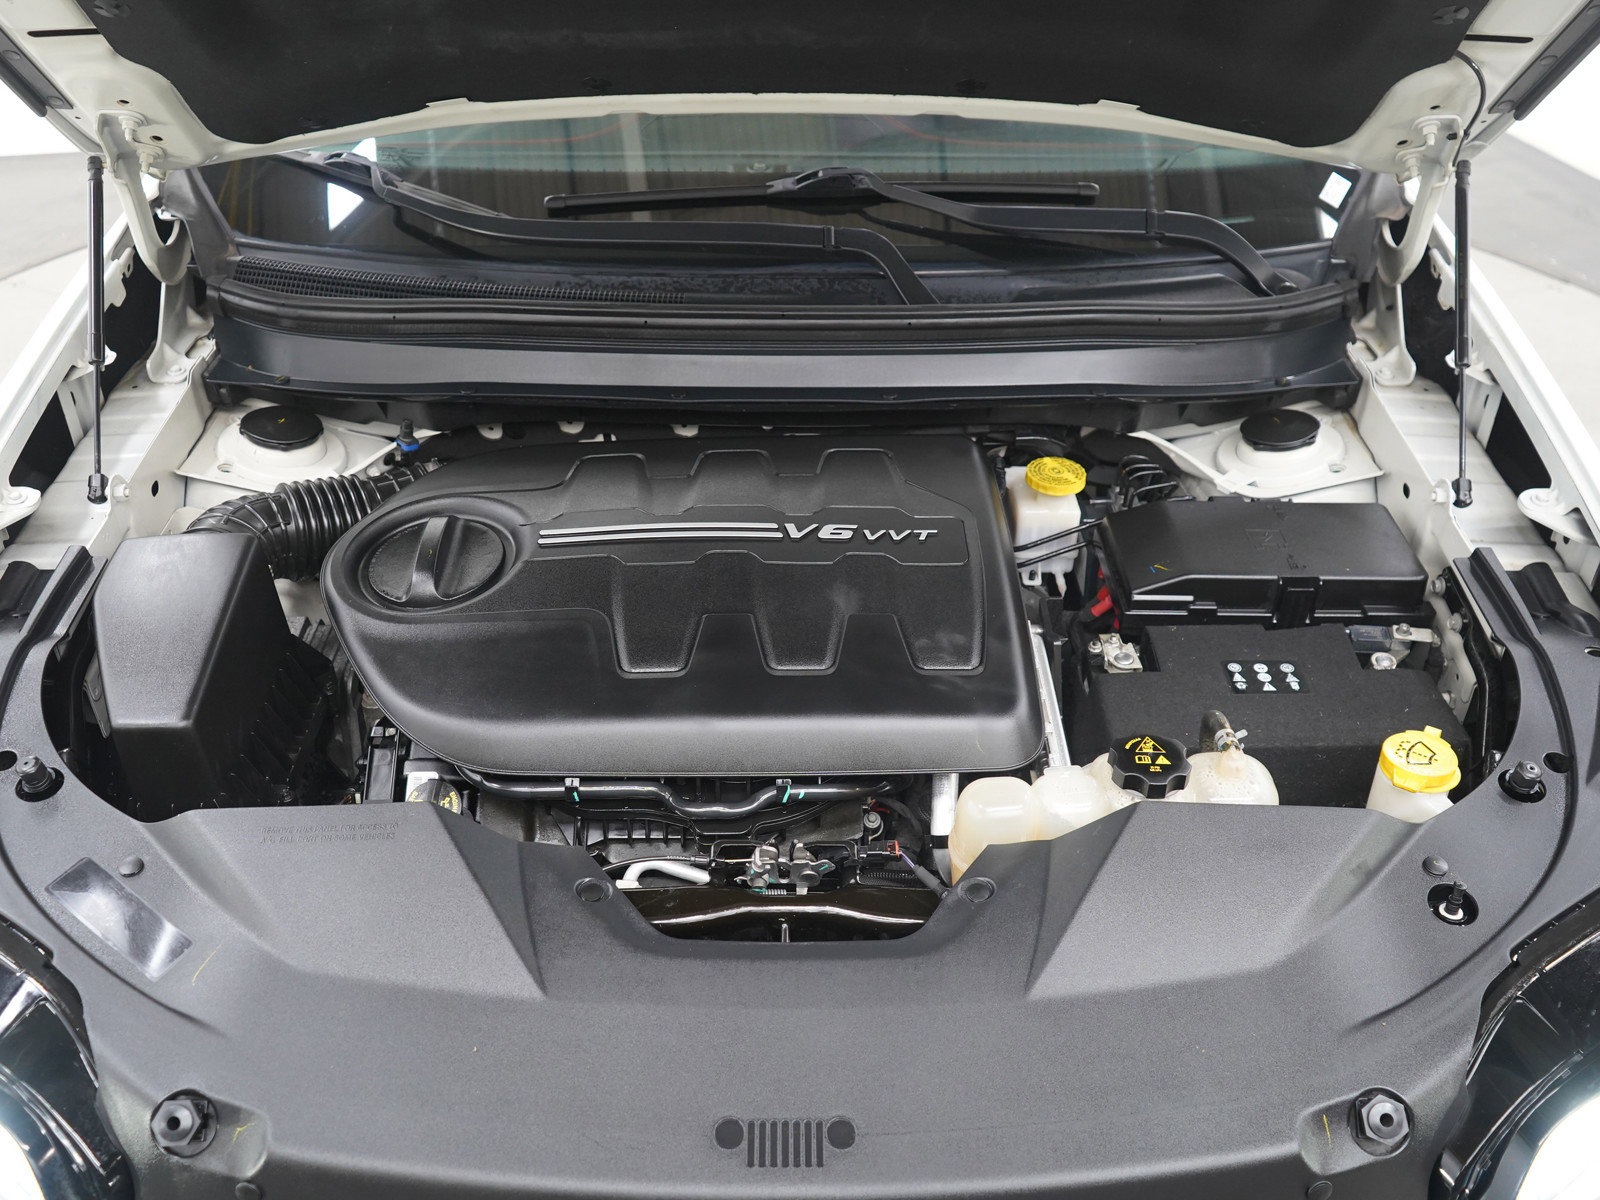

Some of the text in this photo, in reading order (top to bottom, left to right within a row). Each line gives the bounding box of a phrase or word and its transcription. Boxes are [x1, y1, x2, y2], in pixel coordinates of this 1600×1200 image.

[784, 523, 938, 541] V6 VVT
[320, 834, 333, 842] ON
[335, 833, 357, 841] SOME
[359, 832, 396, 841] VEHICLES
